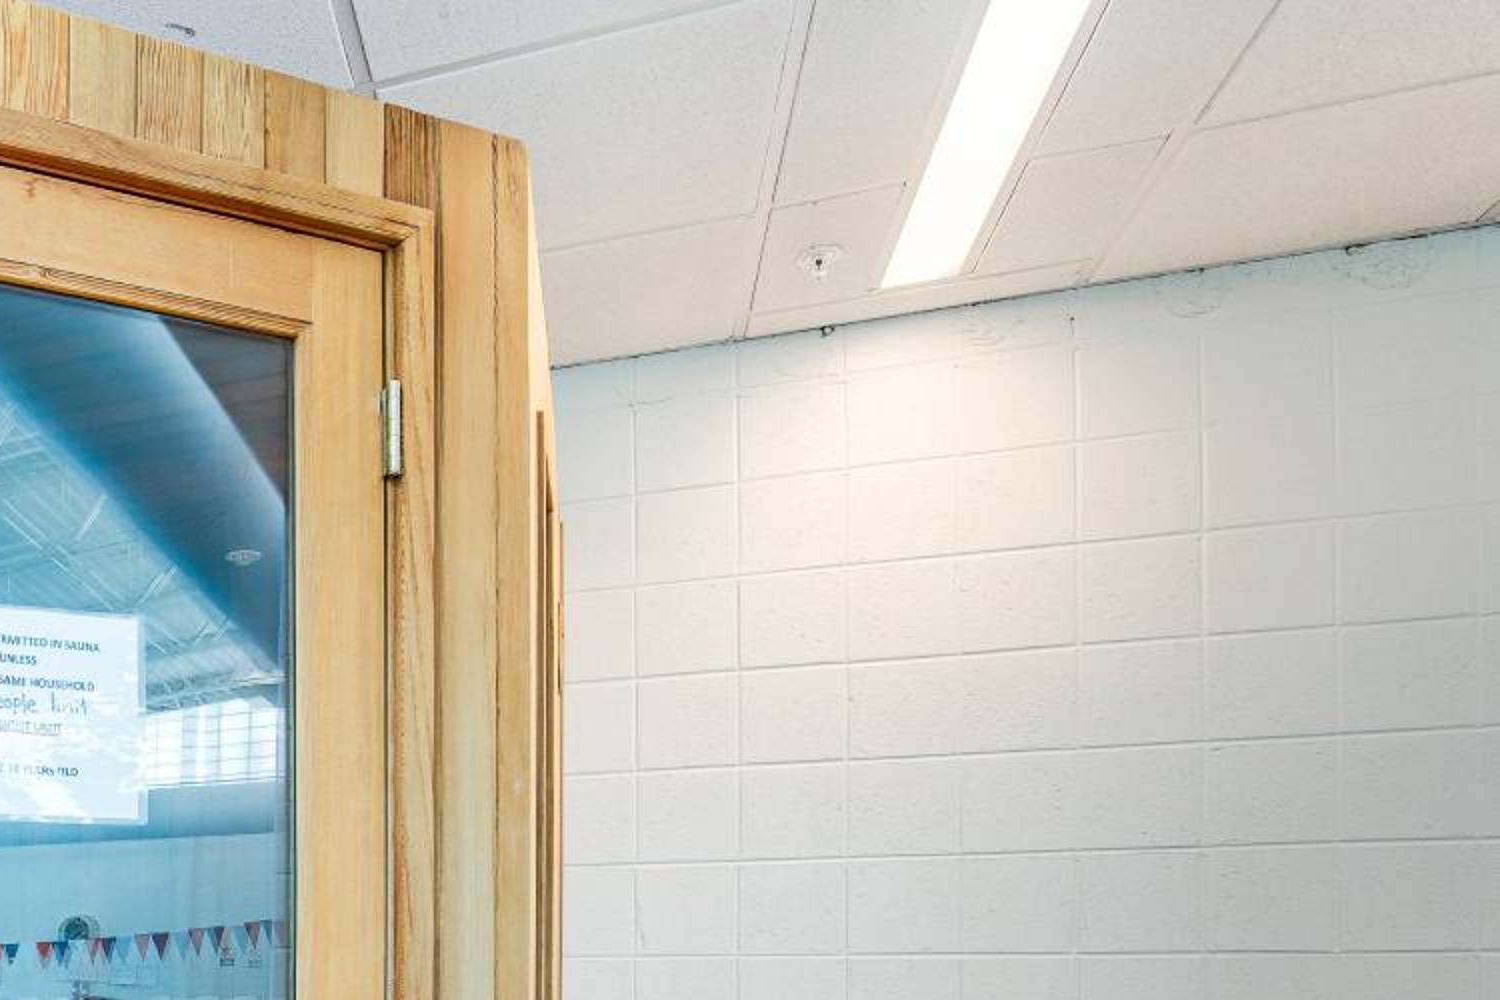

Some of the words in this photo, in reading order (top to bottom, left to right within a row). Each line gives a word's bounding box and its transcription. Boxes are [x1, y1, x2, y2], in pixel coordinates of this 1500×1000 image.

[49, 639, 62, 649] IN
[64, 639, 100, 652] SAUNA
[0, 652, 37, 666] UNLESS
[29, 677, 95, 692] HOUSEHOLD
